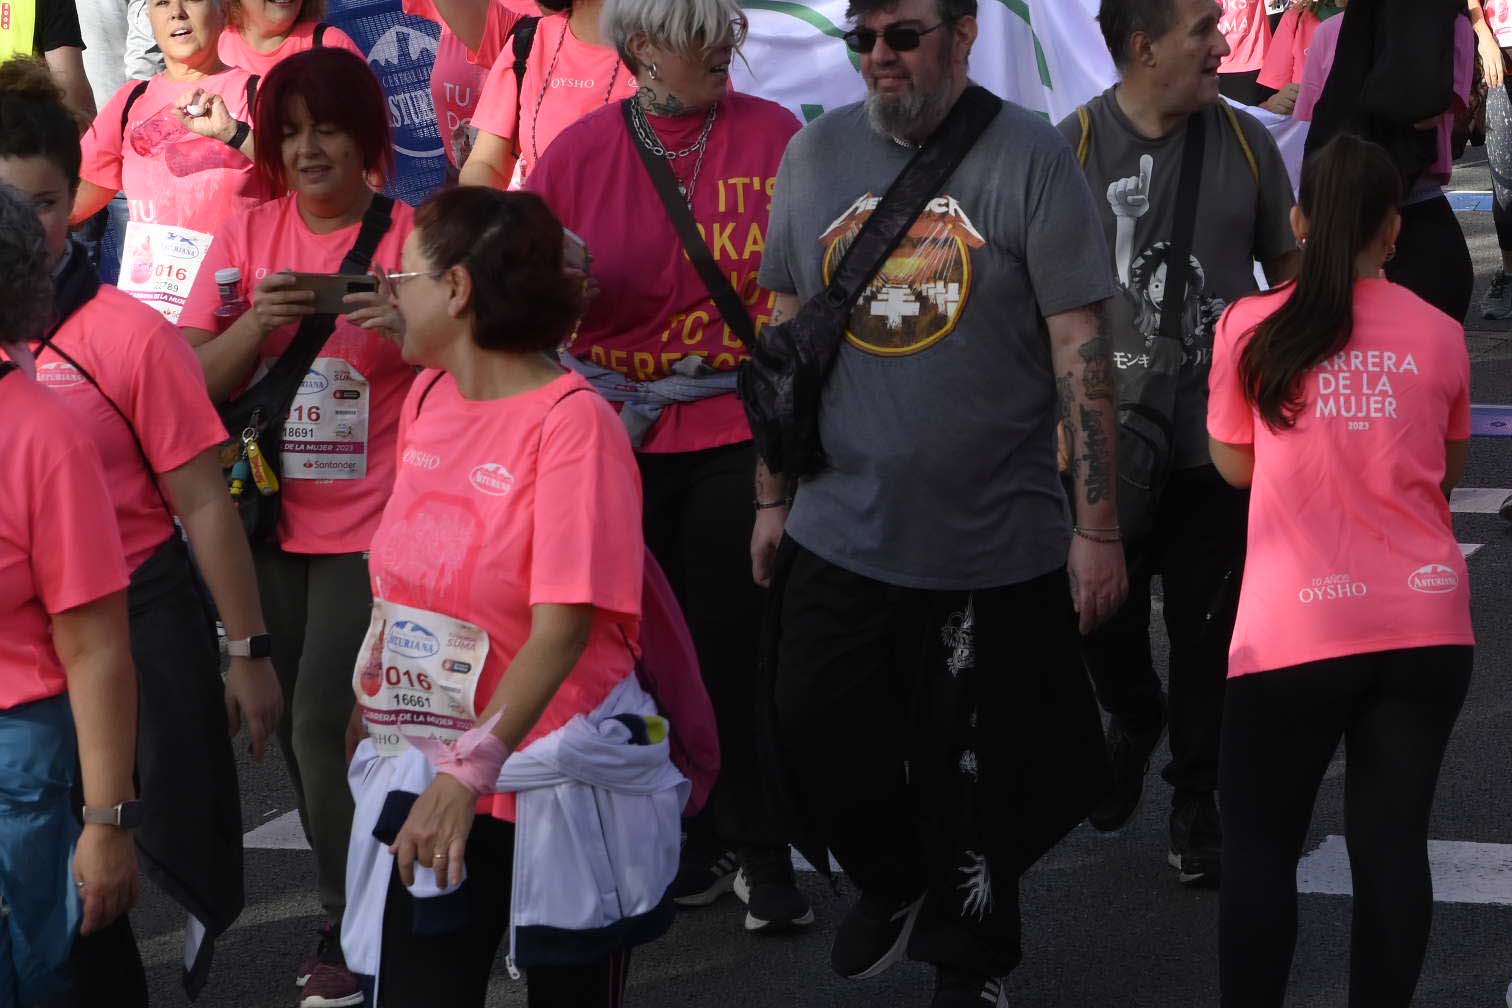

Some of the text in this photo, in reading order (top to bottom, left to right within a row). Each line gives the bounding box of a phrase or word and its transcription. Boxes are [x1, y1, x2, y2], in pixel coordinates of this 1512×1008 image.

[550, 77, 595, 90] OYSHO
[443, 81, 471, 107] TU
[130, 199, 156, 222] TU
[682, 222, 766, 262] KA
[155, 264, 188, 282] 016
[1301, 350, 1420, 375] ARRERA
[1319, 372, 1392, 395] DE LA
[288, 405, 321, 422] 16
[1315, 396, 1398, 419] MUJER
[284, 427, 314, 439] 18691
[1347, 421, 1370, 430] 2023
[313, 459, 357, 470] Santander
[1299, 582, 1367, 603] OYSHO
[385, 665, 433, 692] 016
[393, 694, 431, 708] 16661
[400, 713, 411, 722] DE
[416, 713, 426, 723] LA
[427, 715, 453, 726] MUJER
